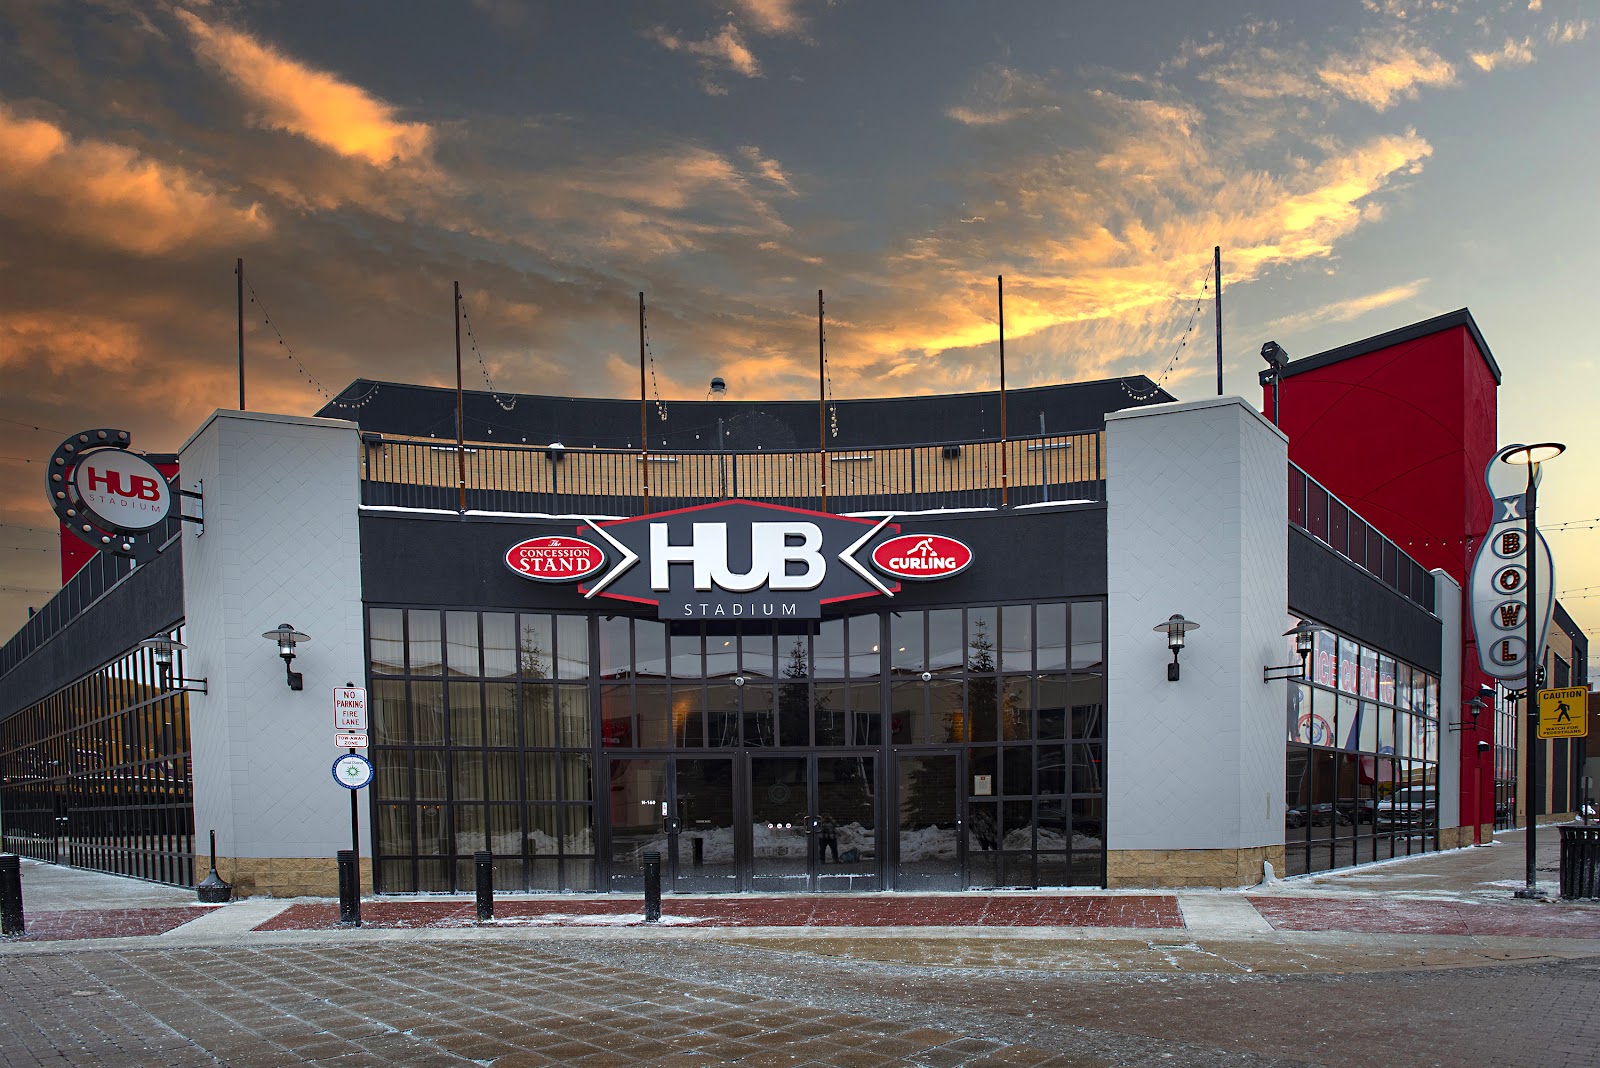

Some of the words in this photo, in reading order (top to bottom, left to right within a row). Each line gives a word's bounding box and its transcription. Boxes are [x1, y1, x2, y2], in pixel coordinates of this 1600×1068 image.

[88, 467, 160, 501] HUB
[89, 494, 161, 512] STADIUM
[520, 549, 590, 557] CONCESSION
[649, 521, 827, 592] HUB
[520, 558, 591, 571] STAND
[889, 557, 956, 569] CURLING
[1500, 533, 1521, 661] BOWL
[684, 603, 796, 615] STADIUM
[1314, 648, 1337, 688] ICE
[1341, 660, 1393, 704] CURLING
[343, 691, 356, 699] NO
[1543, 691, 1582, 700] CAUTION
[336, 700, 363, 708] PARKING
